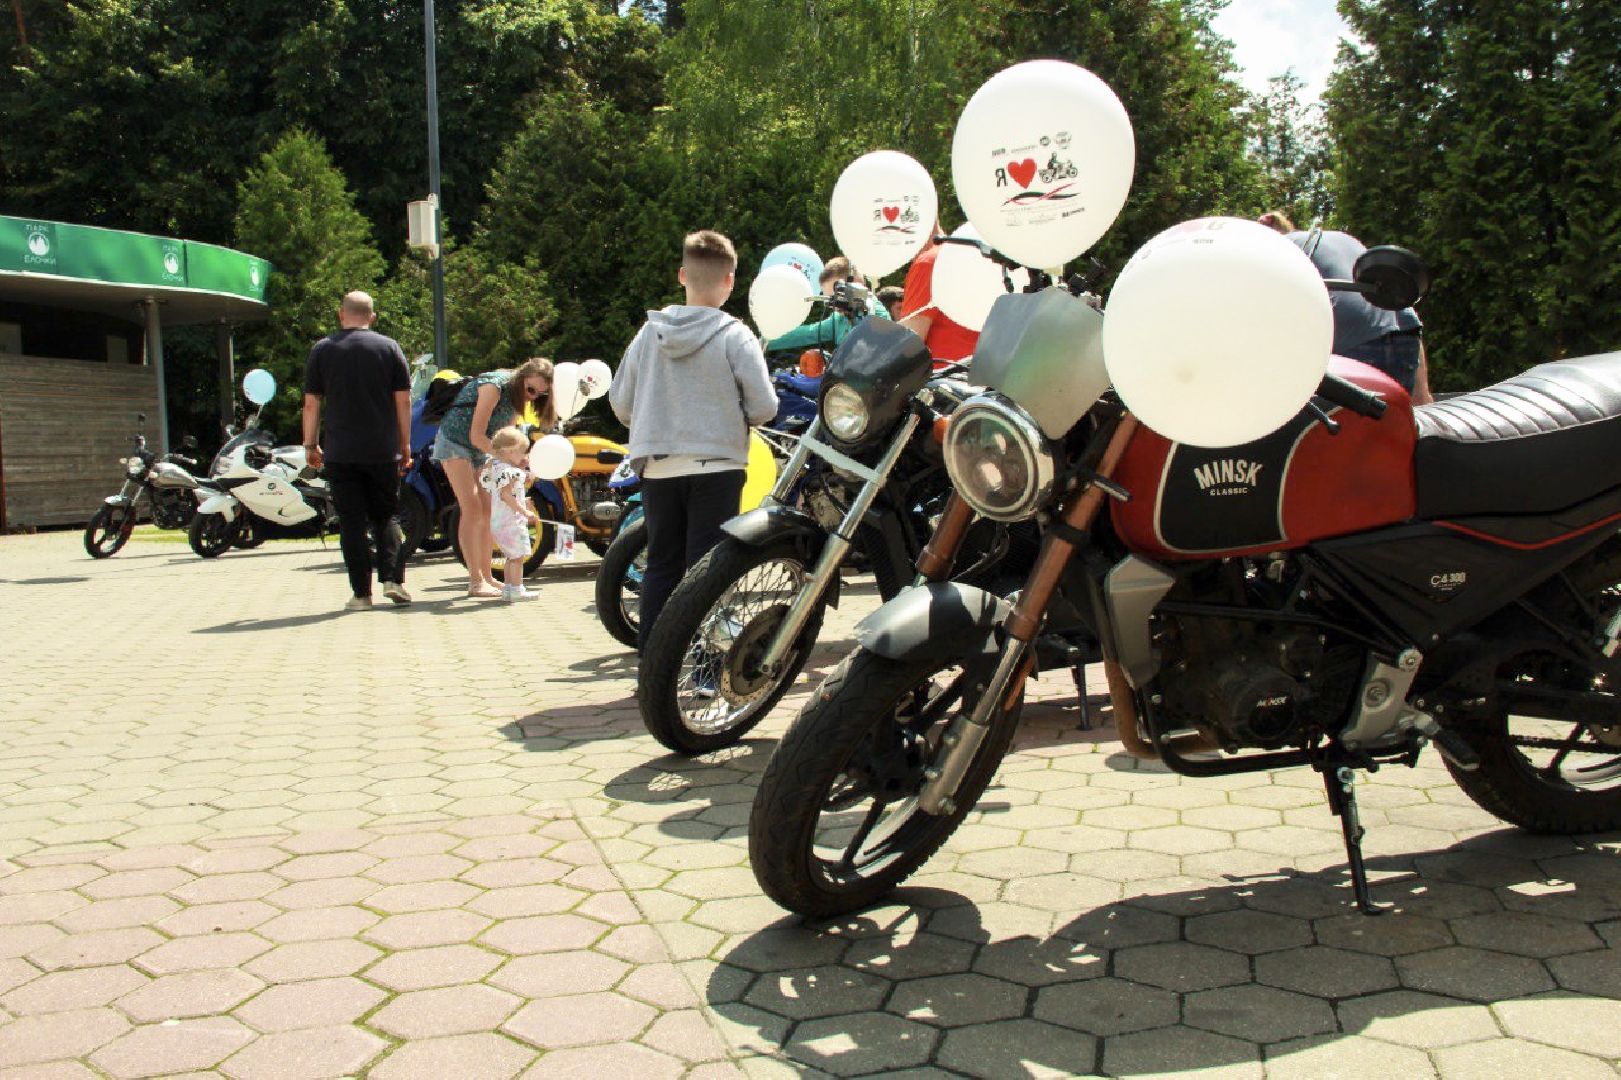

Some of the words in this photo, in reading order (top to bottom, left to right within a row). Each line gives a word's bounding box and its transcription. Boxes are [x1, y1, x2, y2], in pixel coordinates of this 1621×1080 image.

[995, 168, 1007, 188] Я
[1194, 459, 1263, 489] MINSK
[1209, 487, 1248, 496] CLASSIC
